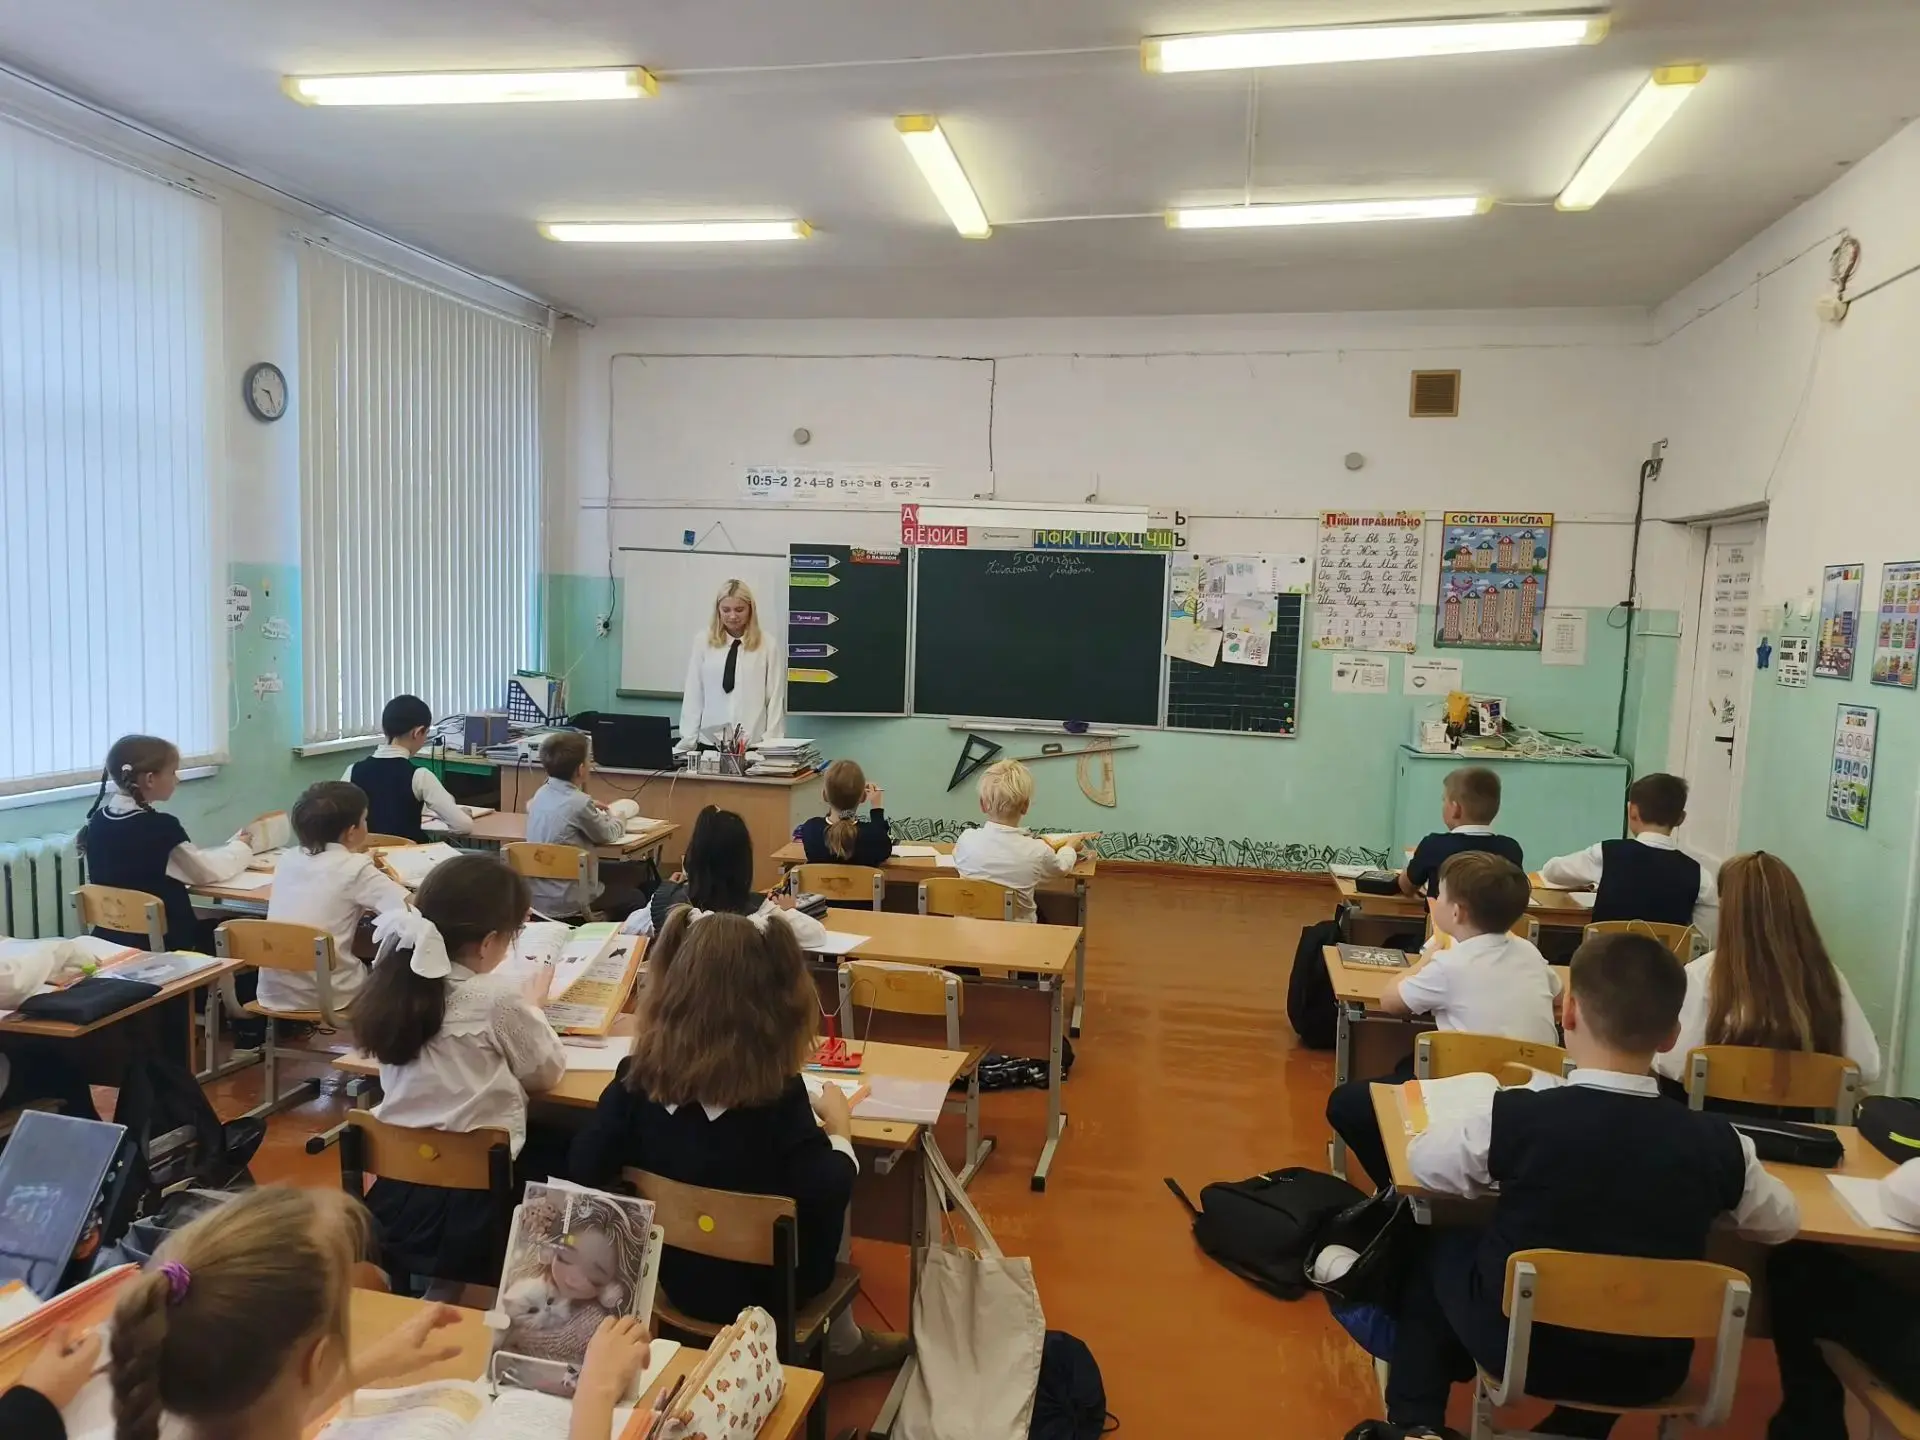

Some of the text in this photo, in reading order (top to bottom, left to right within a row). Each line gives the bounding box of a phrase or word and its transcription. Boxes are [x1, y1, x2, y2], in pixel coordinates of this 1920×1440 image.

[745, 474, 788, 487] 10:5=2
[1361, 517, 1421, 527] ПРАВИЛЬНО
[1451, 514, 1544, 525] СОСТАВ ЧИСЛА
